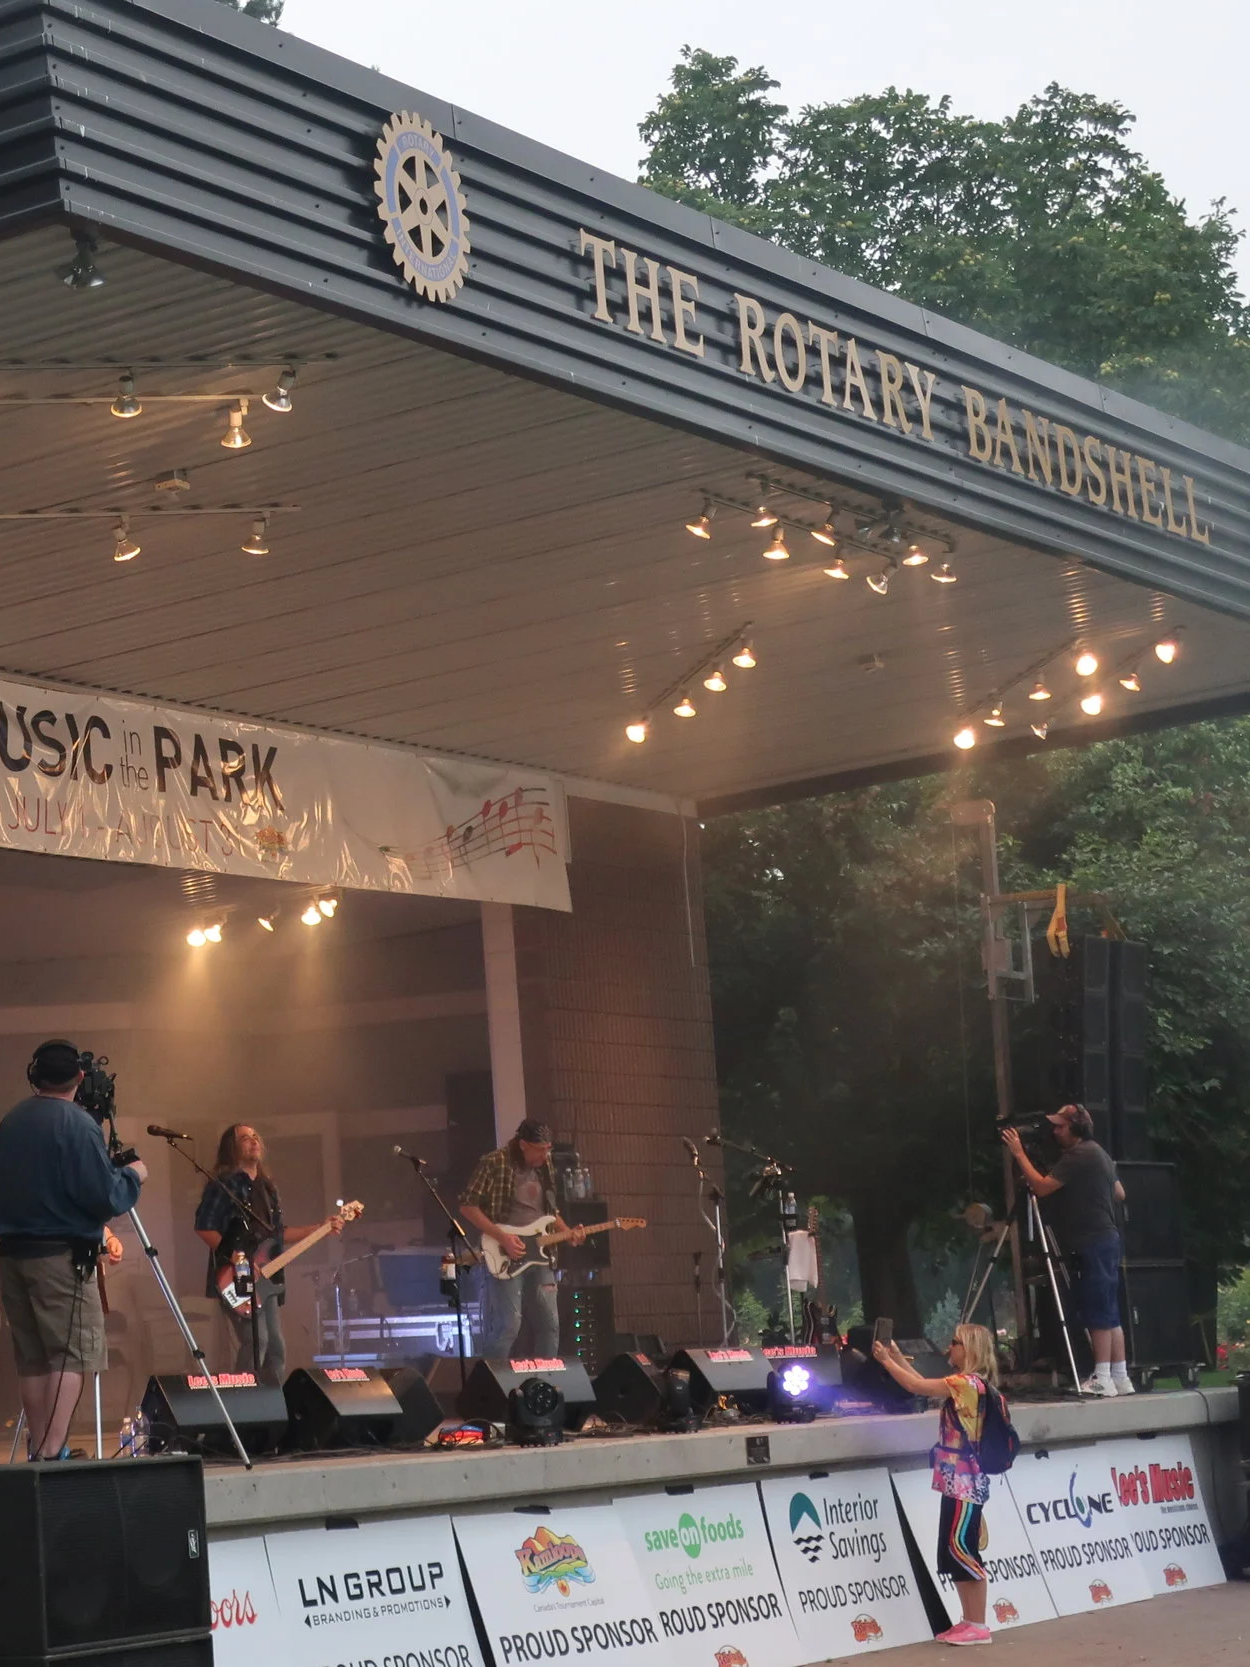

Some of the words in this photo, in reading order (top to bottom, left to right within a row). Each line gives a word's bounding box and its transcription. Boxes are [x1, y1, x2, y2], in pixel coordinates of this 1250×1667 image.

[401, 133, 436, 157] ROTARY
[396, 228, 457, 280] INTERNATIONAL
[579, 228, 704, 358] THE
[734, 292, 935, 441] ROTARY
[961, 385, 1210, 545] BANDSHELL
[122, 719, 142, 757] in
[120, 755, 149, 791] the
[154, 726, 285, 812] PARK
[8, 795, 68, 836] JULY
[116, 810, 214, 854] AUGUST
[784, 1346, 817, 1356] Music
[187, 1375, 218, 1387] Lees
[218, 1373, 255, 1384] Music
[1026, 1471, 1114, 1528] CYCLONE
[1149, 1461, 1195, 1504] Music
[823, 1493, 878, 1526] Interior
[645, 1530, 679, 1551] save
[681, 1527, 700, 1546] on
[700, 1513, 744, 1544] foods
[829, 1528, 887, 1563] Savings
[1132, 1530, 1158, 1554] OUD
[1159, 1524, 1210, 1550] SPONSOR
[515, 1542, 587, 1577] Kamloops
[983, 1554, 1040, 1583] SPONSOR
[1040, 1545, 1082, 1573] PROUD
[1081, 1537, 1134, 1565] SPONSOR
[298, 1575, 339, 1608] LN
[343, 1562, 444, 1601] GROUP
[655, 1572, 688, 1594] Going
[686, 1564, 703, 1585] the
[705, 1566, 731, 1583] extra
[732, 1559, 754, 1579] mile
[798, 1584, 848, 1613] PROUD
[848, 1575, 910, 1604] SPONSOR
[210, 1589, 258, 1631] oors
[313, 1608, 372, 1627] BRANDING
[381, 1598, 444, 1616] PROMOTIONS
[555, 1599, 587, 1611] Tournament
[659, 1606, 707, 1637] ROUD
[710, 1593, 782, 1628] SPONSOR
[500, 1629, 570, 1665] PROUD
[570, 1618, 659, 1654] SPONSOR
